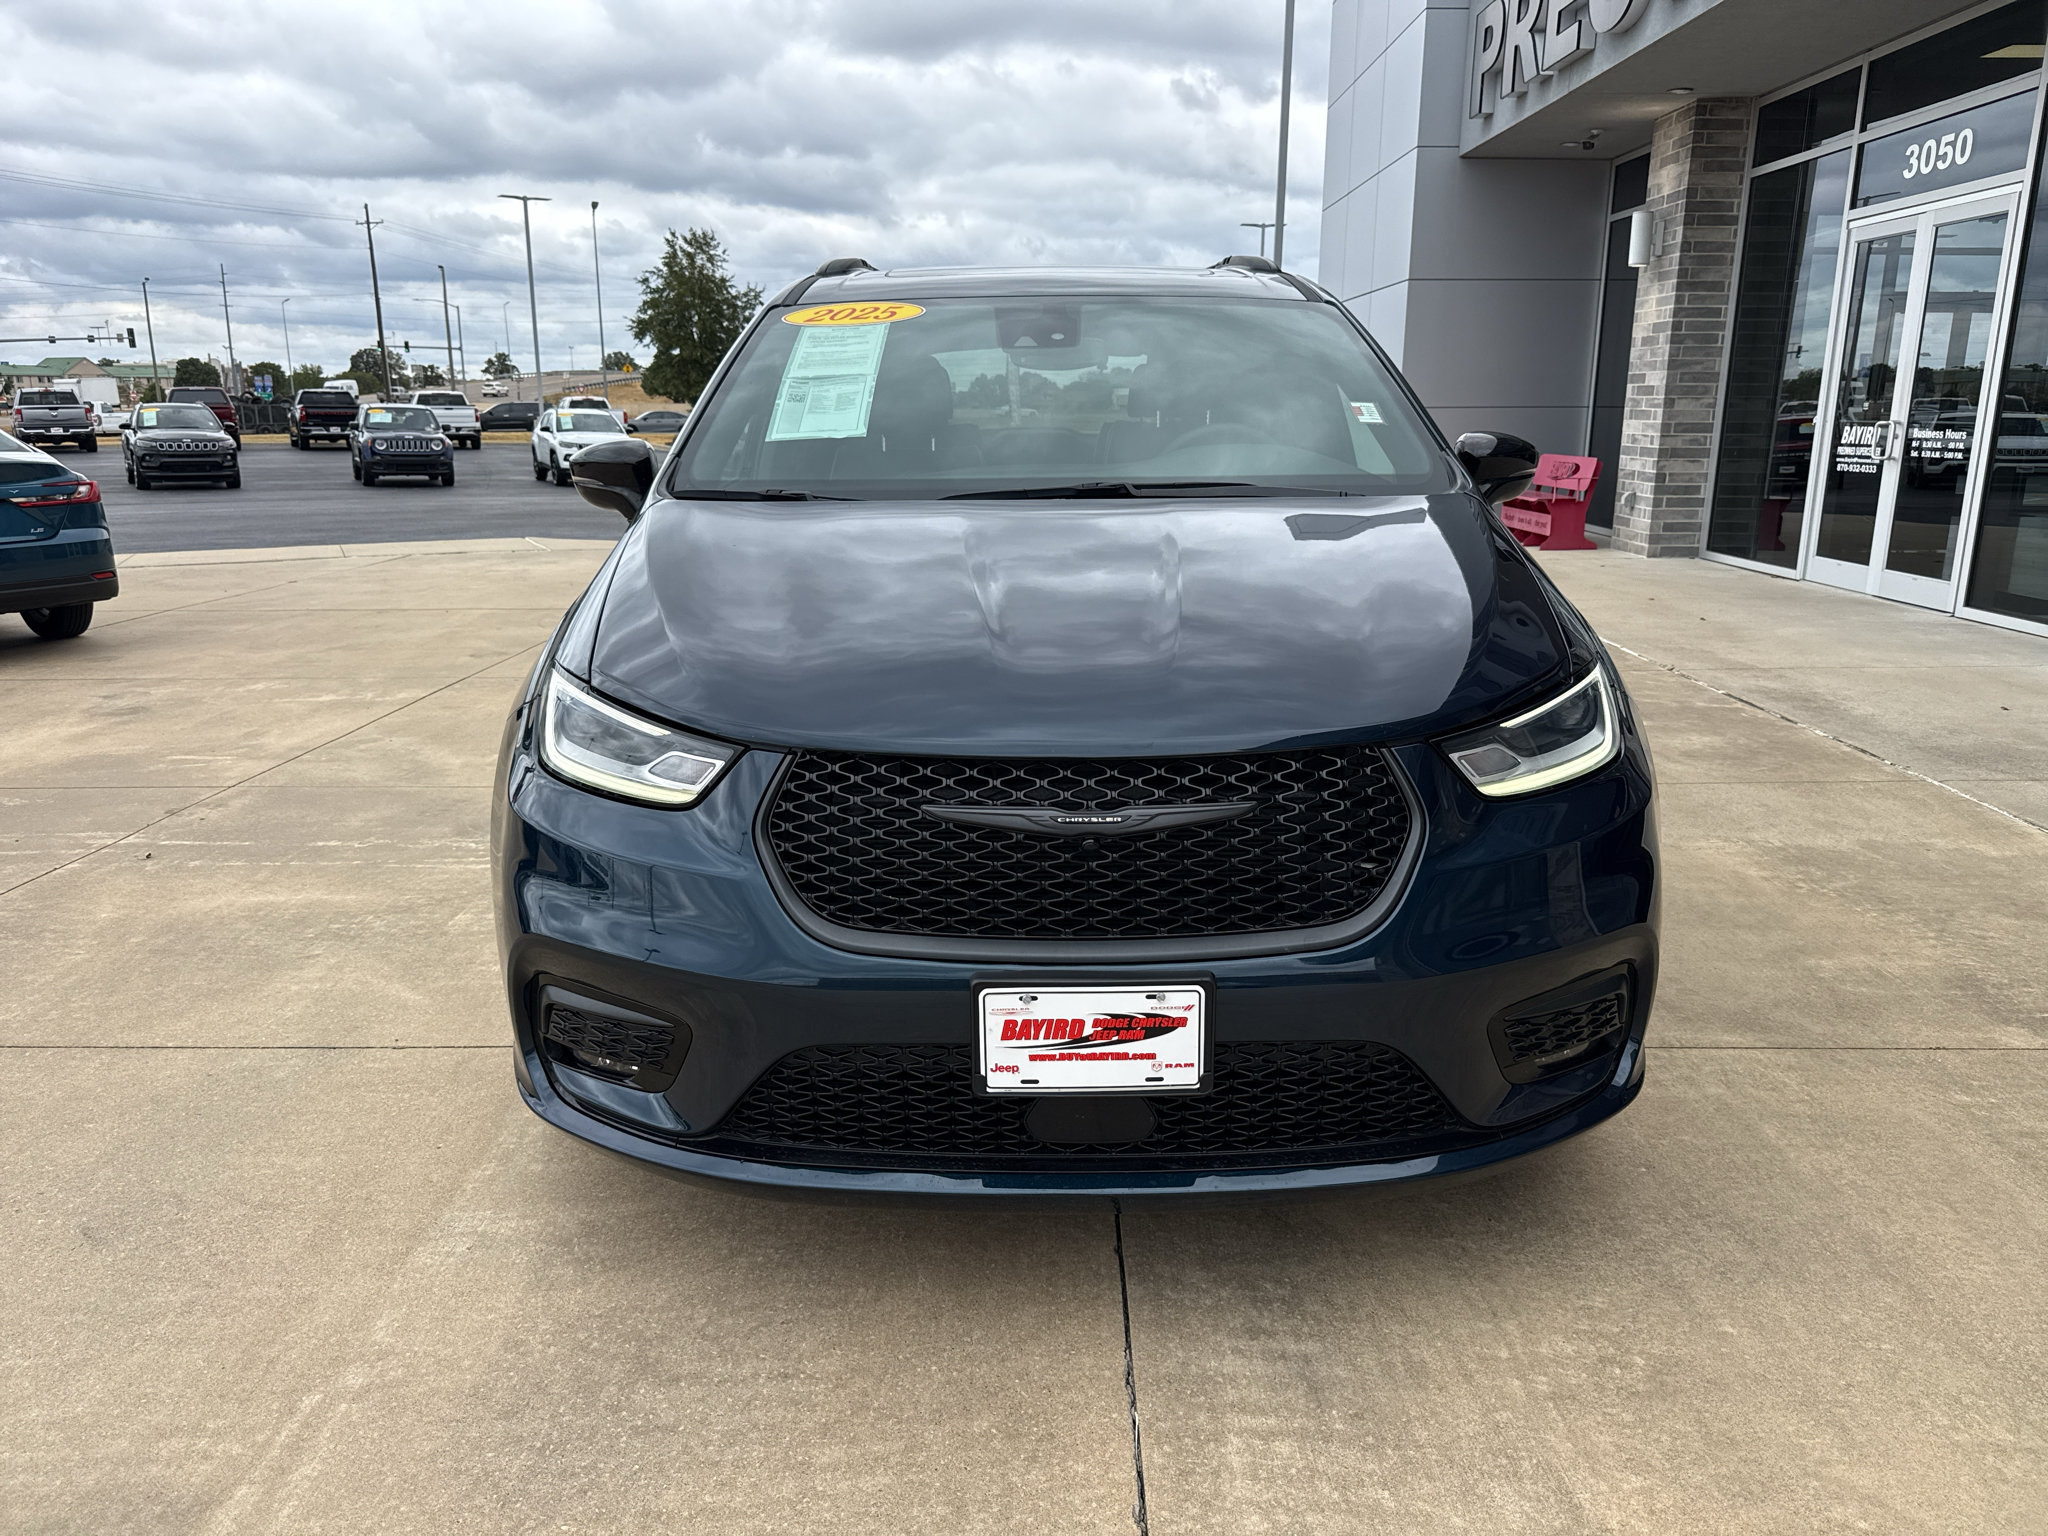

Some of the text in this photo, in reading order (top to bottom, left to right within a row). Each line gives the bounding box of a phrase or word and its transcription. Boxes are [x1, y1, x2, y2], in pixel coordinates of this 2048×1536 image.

[1902, 128, 1974, 179] 3050
[803, 306, 905, 323] 2025
[1912, 427, 1967, 440] Business Hours
[1836, 463, 1877, 473] 870-932-0333
[1091, 1016, 1188, 1029] DODGE CHRYSLER
[1000, 1018, 1086, 1041] BAYIRD
[1089, 1029, 1146, 1041] JEEP RAM
[990, 1063, 1019, 1074] Jeep
